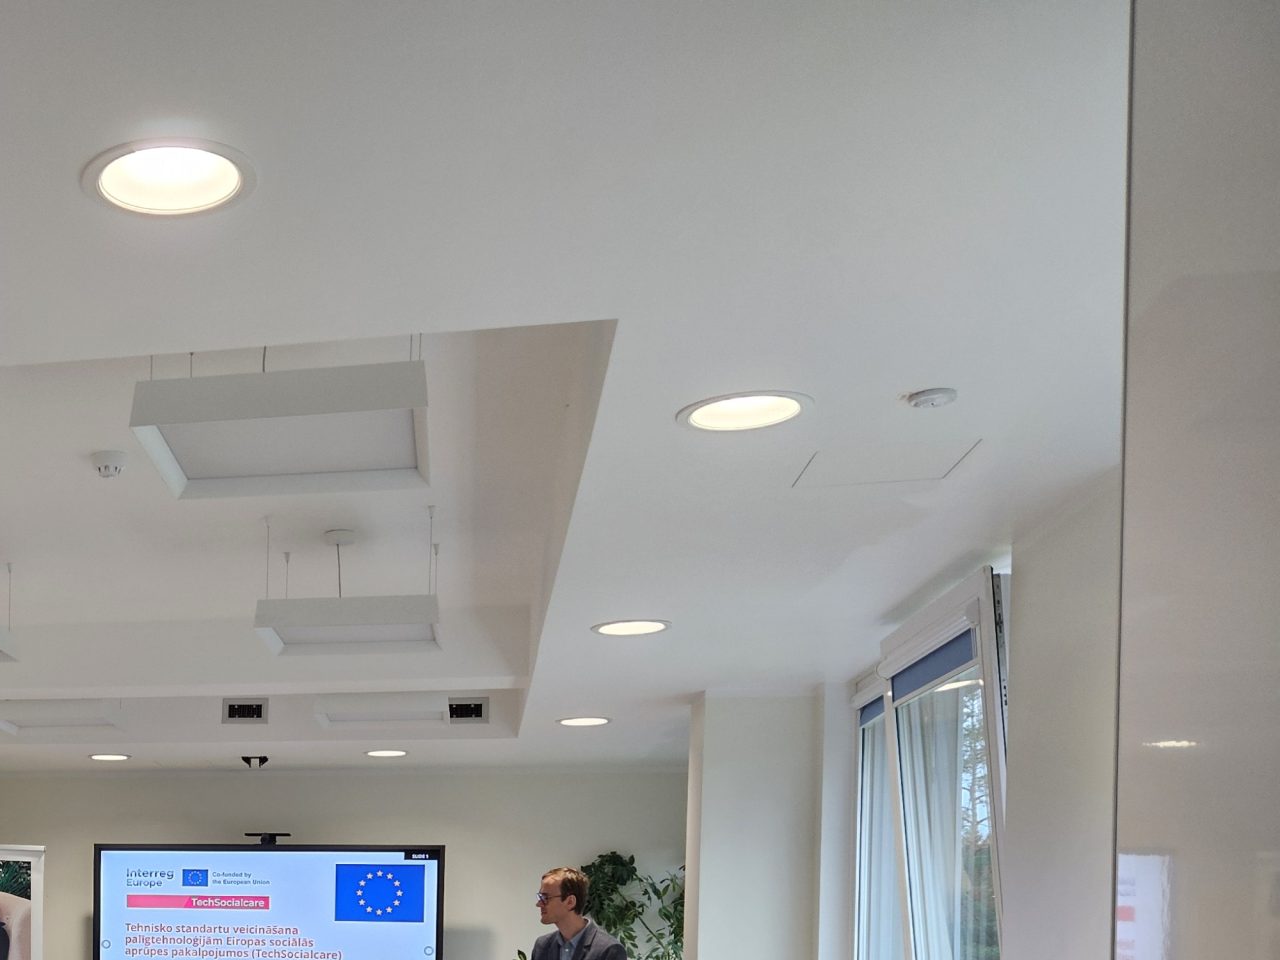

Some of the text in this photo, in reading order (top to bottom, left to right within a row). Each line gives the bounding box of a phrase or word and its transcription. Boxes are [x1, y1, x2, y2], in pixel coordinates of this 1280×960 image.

[126, 868, 174, 880] Interreg
[126, 879, 163, 888] Europe
[191, 897, 265, 908] TechSocialcare
[125, 923, 299, 935] Tehnisko standartu veicināšana
[125, 935, 314, 948] palīgtehnoloģijām Eiropas sociālās
[125, 947, 342, 960] aprūpes pakalpojumos (TechSocialcare)
